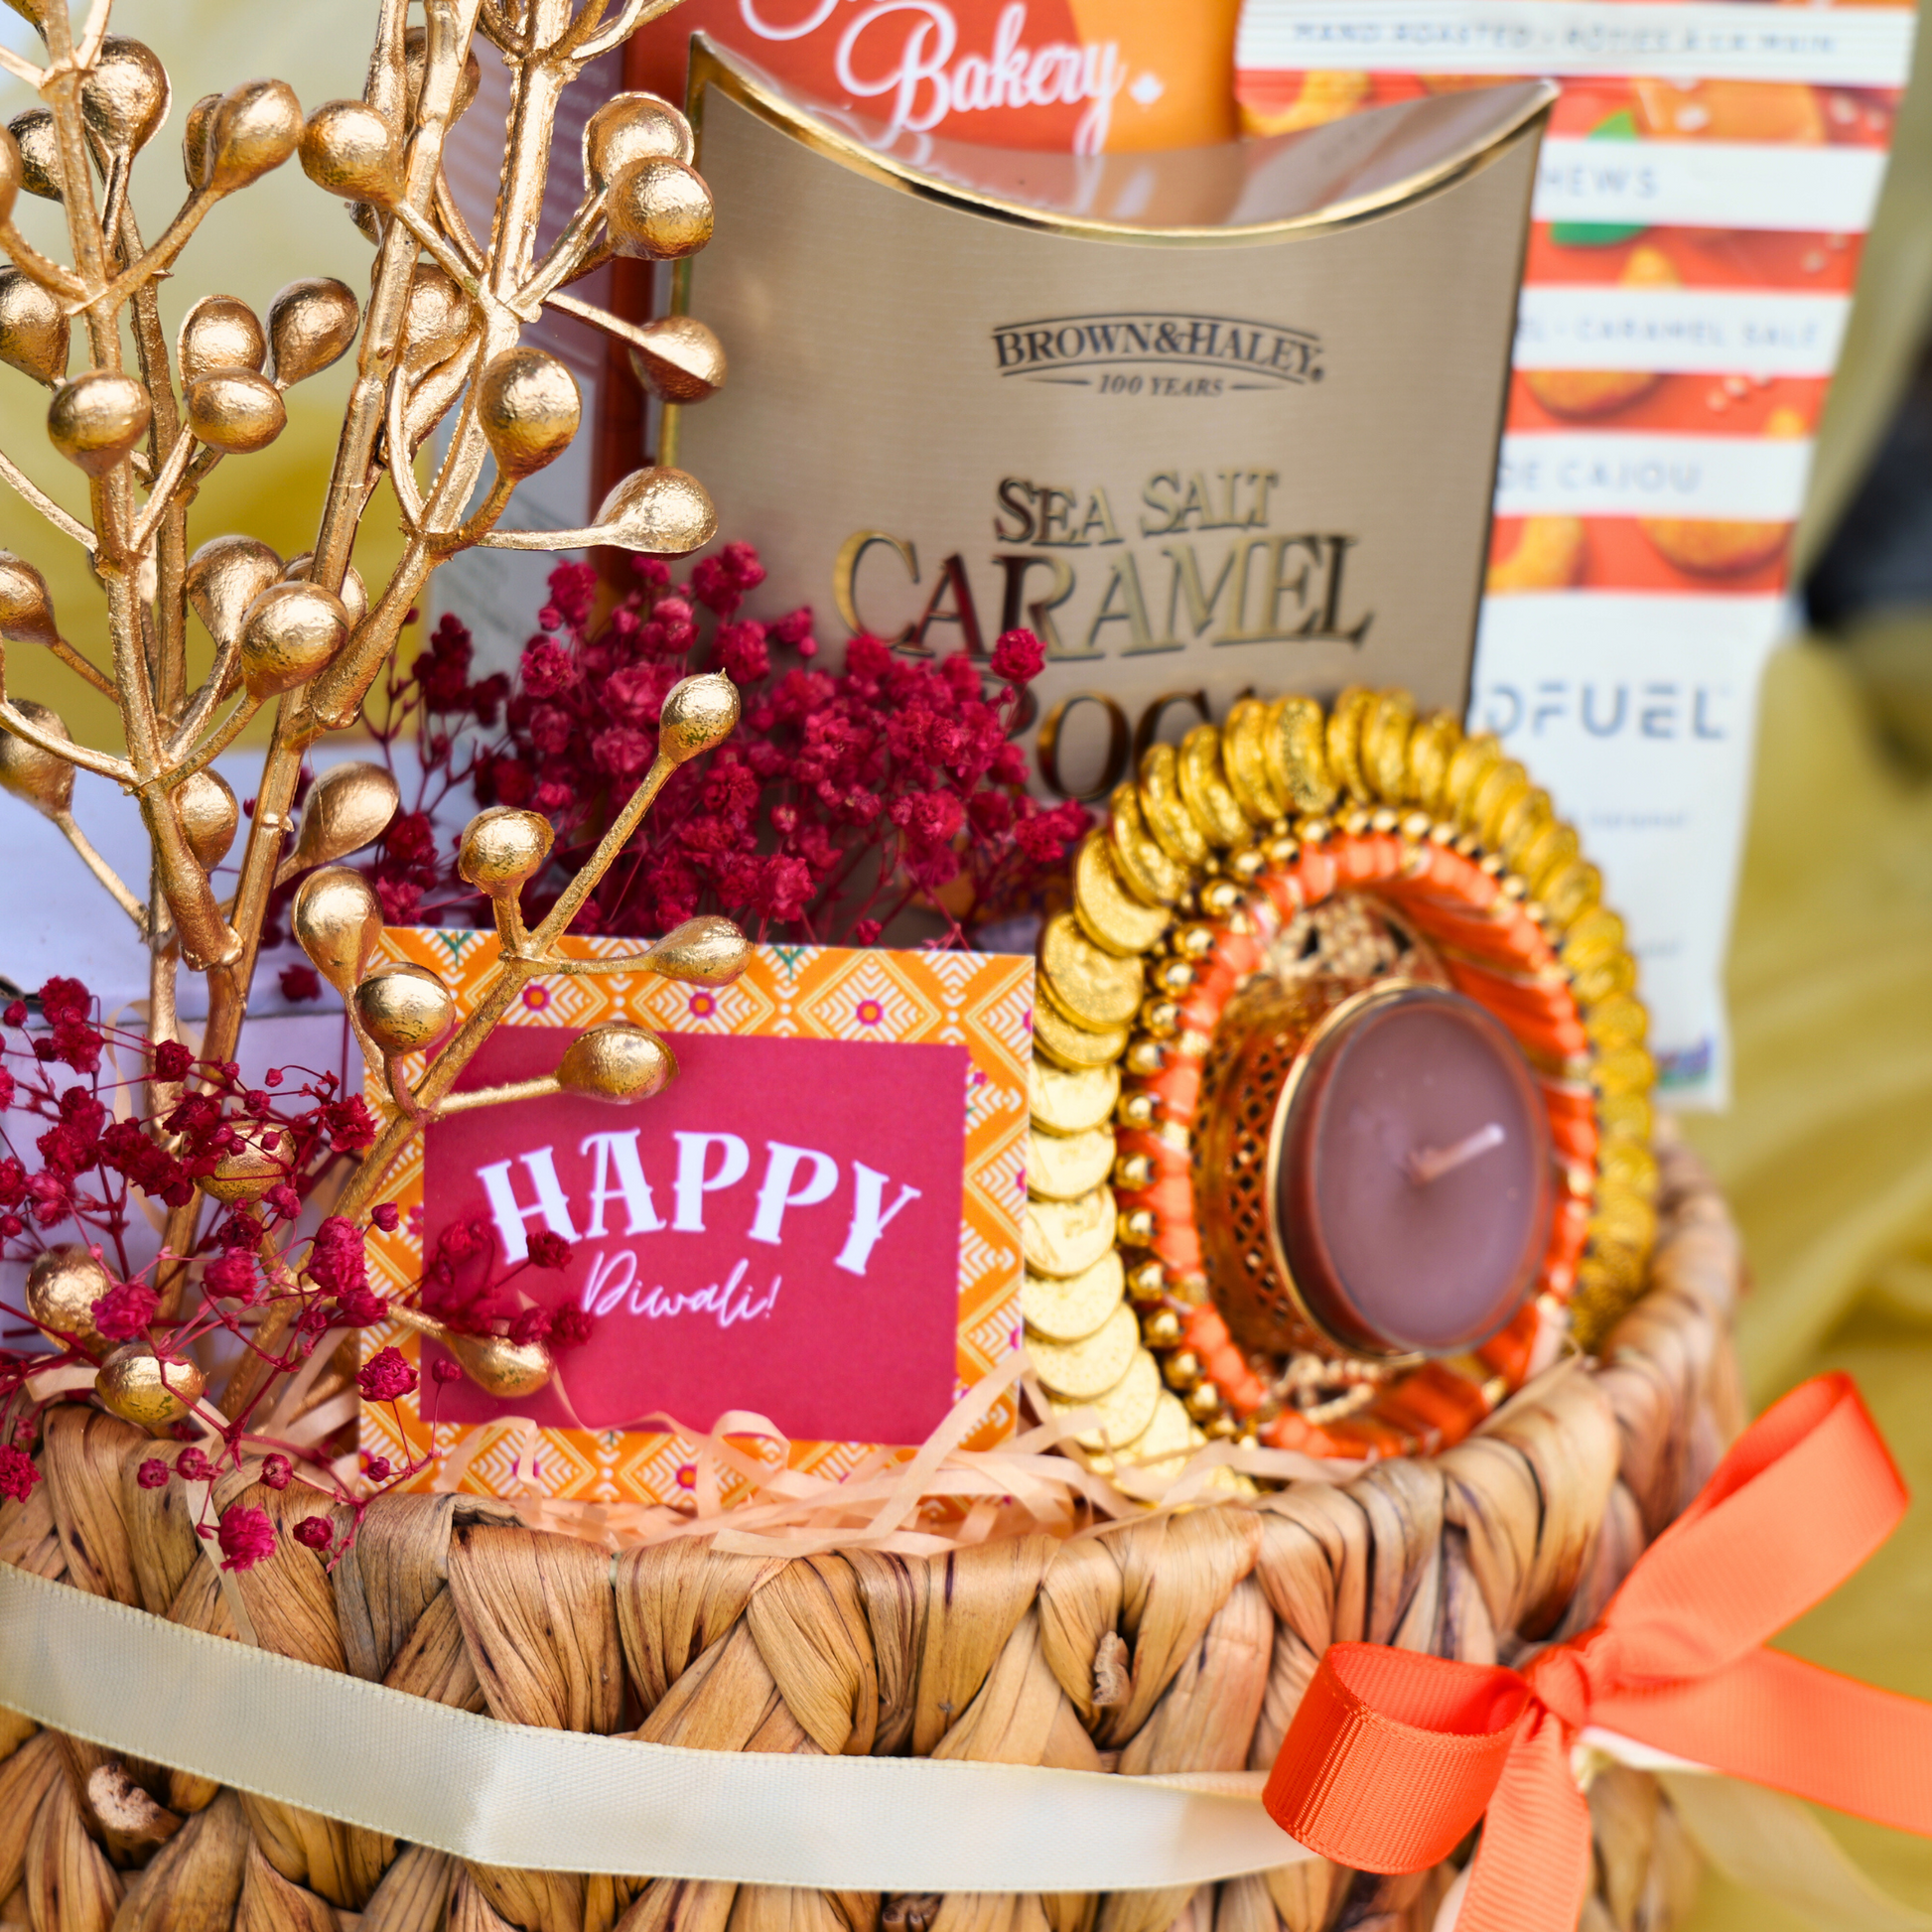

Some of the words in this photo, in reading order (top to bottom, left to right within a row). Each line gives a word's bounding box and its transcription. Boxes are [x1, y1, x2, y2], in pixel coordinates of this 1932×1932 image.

[836, 0, 1116, 154] Bakery
[1098, 373, 1143, 395] 100
[1150, 376, 1224, 397] YEARS
[994, 477, 1124, 547] SEA
[1140, 468, 1280, 537] SALT
[1555, 457, 1704, 495] CAJOU
[832, 529, 1375, 662] CARAMEL
[476, 1128, 922, 1276] HAPPY
[581, 1249, 783, 1328] Diwali!
